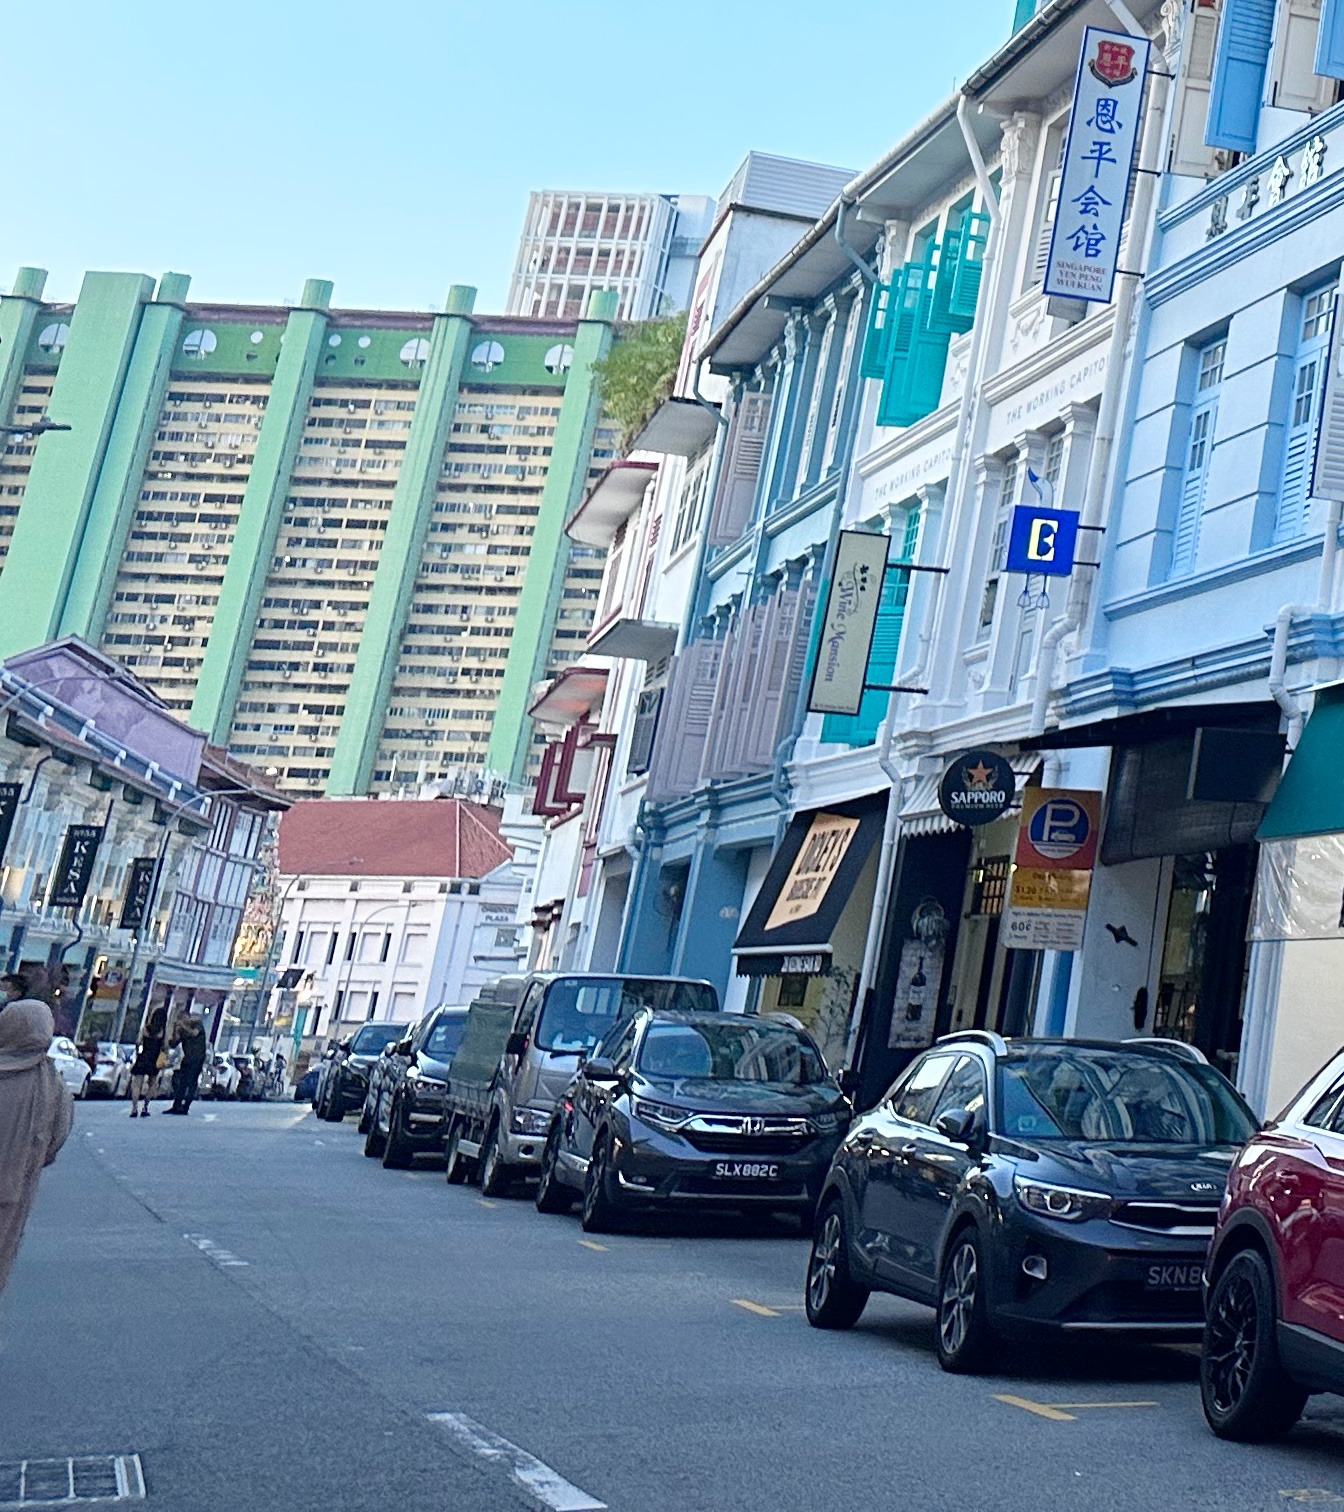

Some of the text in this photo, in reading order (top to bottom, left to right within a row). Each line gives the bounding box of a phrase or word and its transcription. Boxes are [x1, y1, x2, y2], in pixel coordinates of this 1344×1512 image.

[1066, 98, 1123, 258] 恩平会馆
[1006, 405, 1023, 426] THE
[1026, 380, 1066, 415] WORKING
[950, 790, 1006, 804] SAPPORO
[1042, 803, 1081, 842] P
